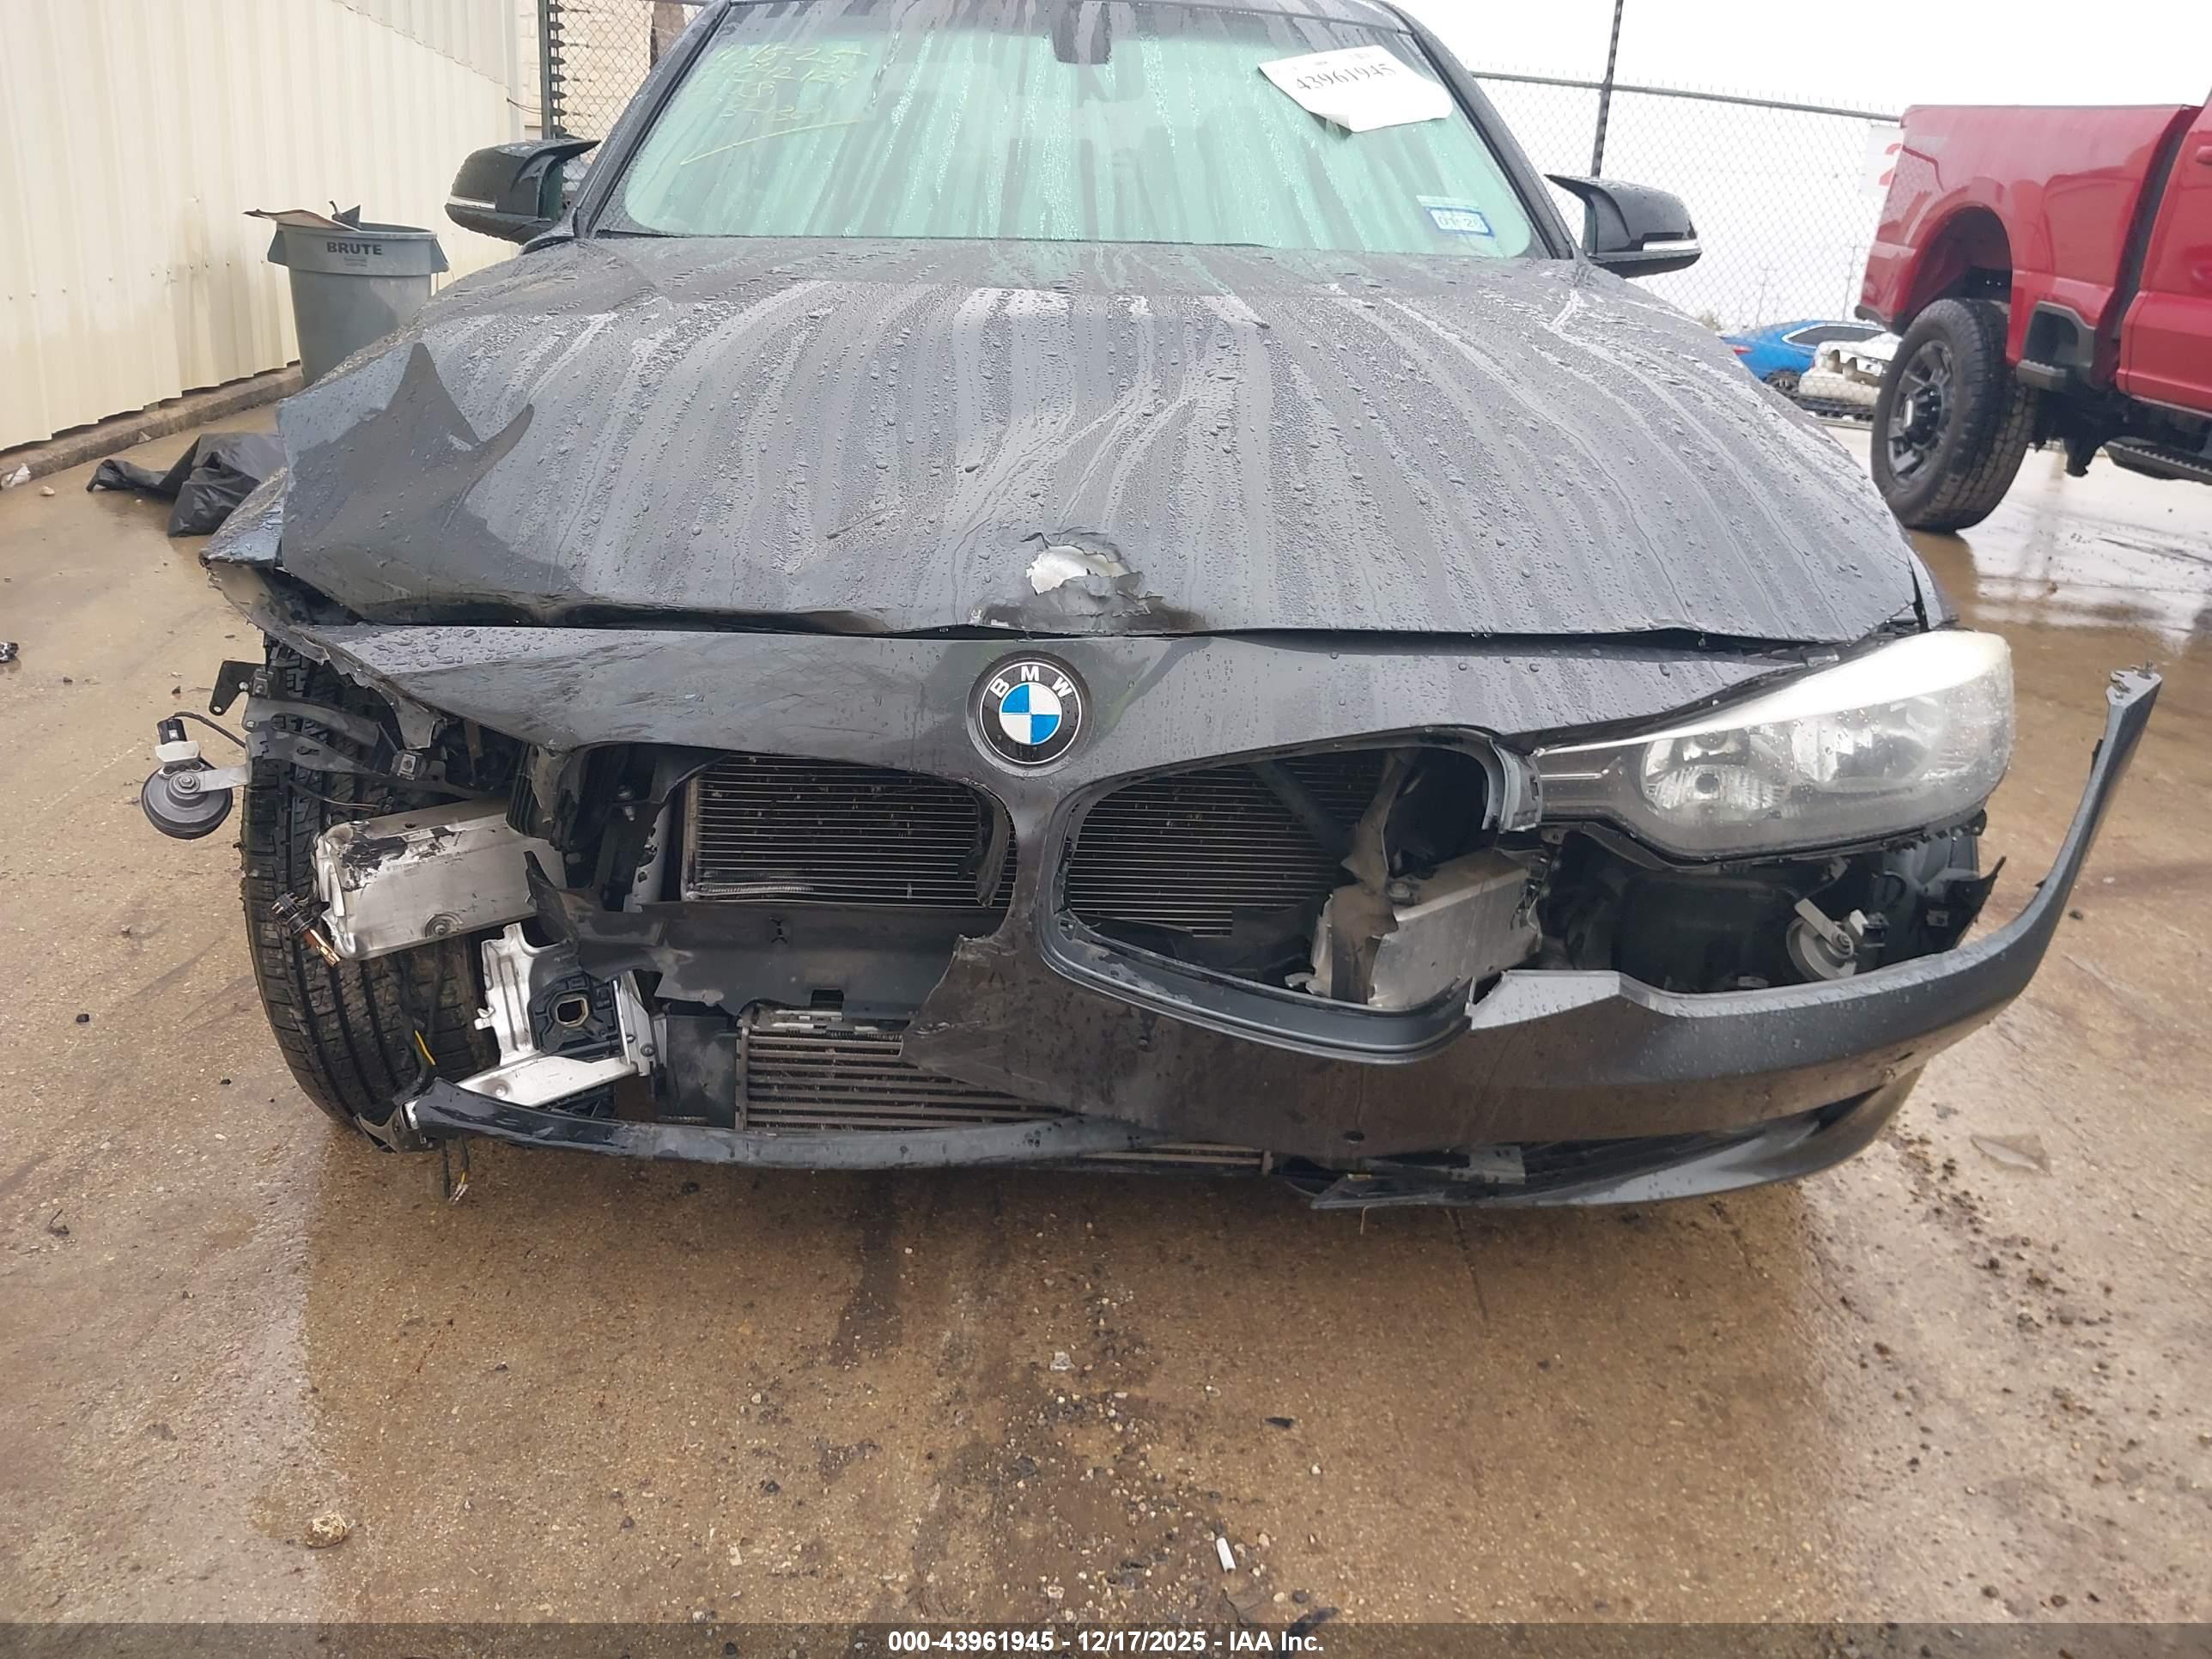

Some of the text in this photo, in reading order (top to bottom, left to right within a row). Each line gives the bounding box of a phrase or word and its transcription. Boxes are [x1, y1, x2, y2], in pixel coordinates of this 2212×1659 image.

[1296, 63, 1397, 90] 43961945
[326, 241, 383, 255] BRUTE
[989, 665, 1073, 699] BMW
